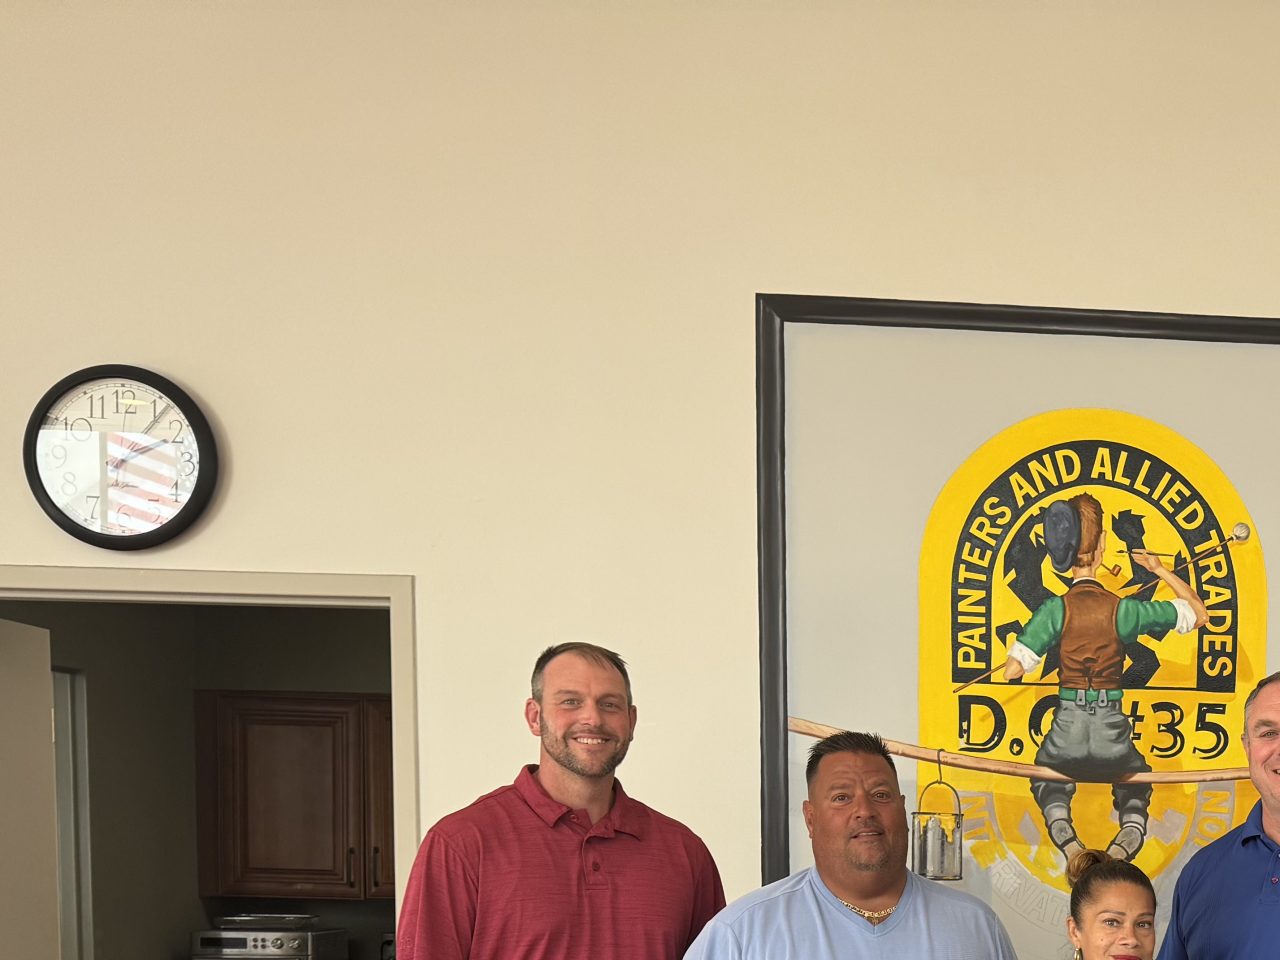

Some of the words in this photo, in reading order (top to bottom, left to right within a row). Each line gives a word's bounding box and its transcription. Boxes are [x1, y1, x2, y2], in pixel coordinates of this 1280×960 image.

[87, 394, 109, 419] 11
[112, 389, 137, 414] 12
[150, 399, 160, 423] 1
[63, 416, 92, 442] 10
[169, 419, 184, 444] 2
[51, 445, 67, 469] 9
[181, 451, 196, 477] 3
[61, 472, 78, 496] 8
[169, 479, 182, 503] 4
[86, 495, 100, 520] 7
[957, 496, 1012, 669] PAINTERS
[1008, 449, 1081, 508] AND
[1090, 447, 1206, 530] ALLIED
[1194, 529, 1233, 677] TRADES
